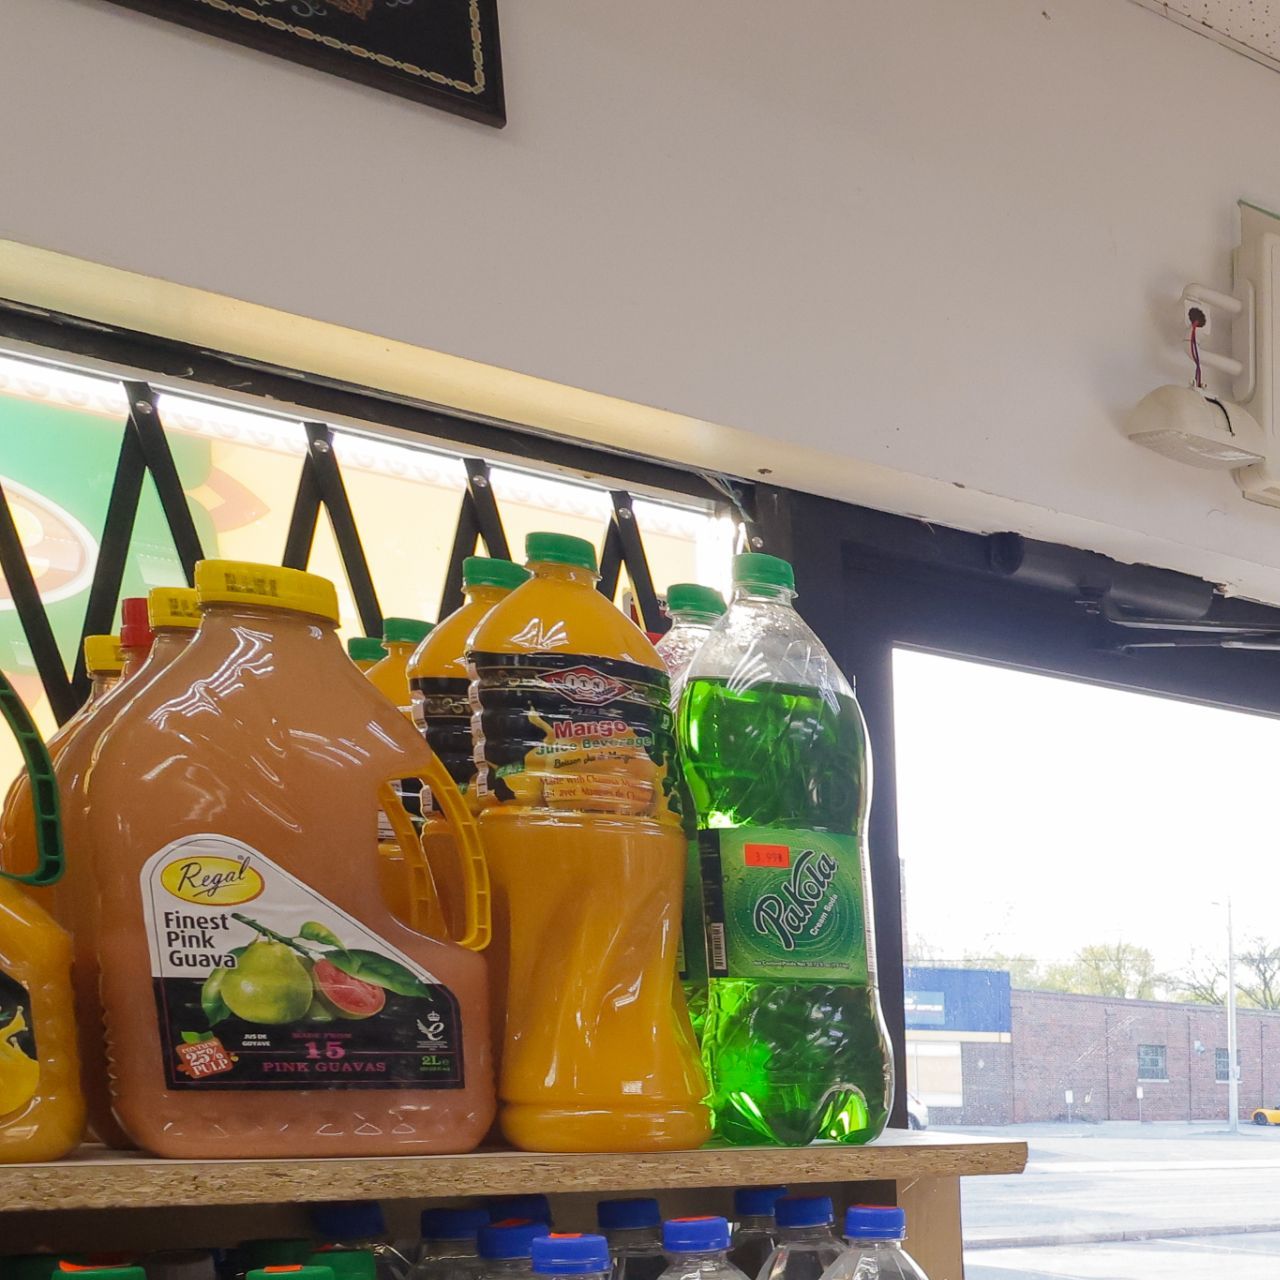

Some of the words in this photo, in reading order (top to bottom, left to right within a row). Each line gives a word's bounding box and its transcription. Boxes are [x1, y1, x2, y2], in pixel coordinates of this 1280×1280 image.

[553, 720, 629, 740] Mango
[178, 856, 249, 896] Regal
[753, 849, 839, 950] Pakola
[164, 911, 230, 930] Finest
[166, 931, 216, 949] Pink
[169, 950, 236, 968] Guava
[185, 1044, 225, 1067] 25%
[304, 1041, 345, 1059] 15
[193, 1058, 229, 1077] PULP
[263, 1062, 309, 1072] PINK
[314, 1062, 386, 1072] GUAVAS
[421, 1055, 441, 1066] 2L
